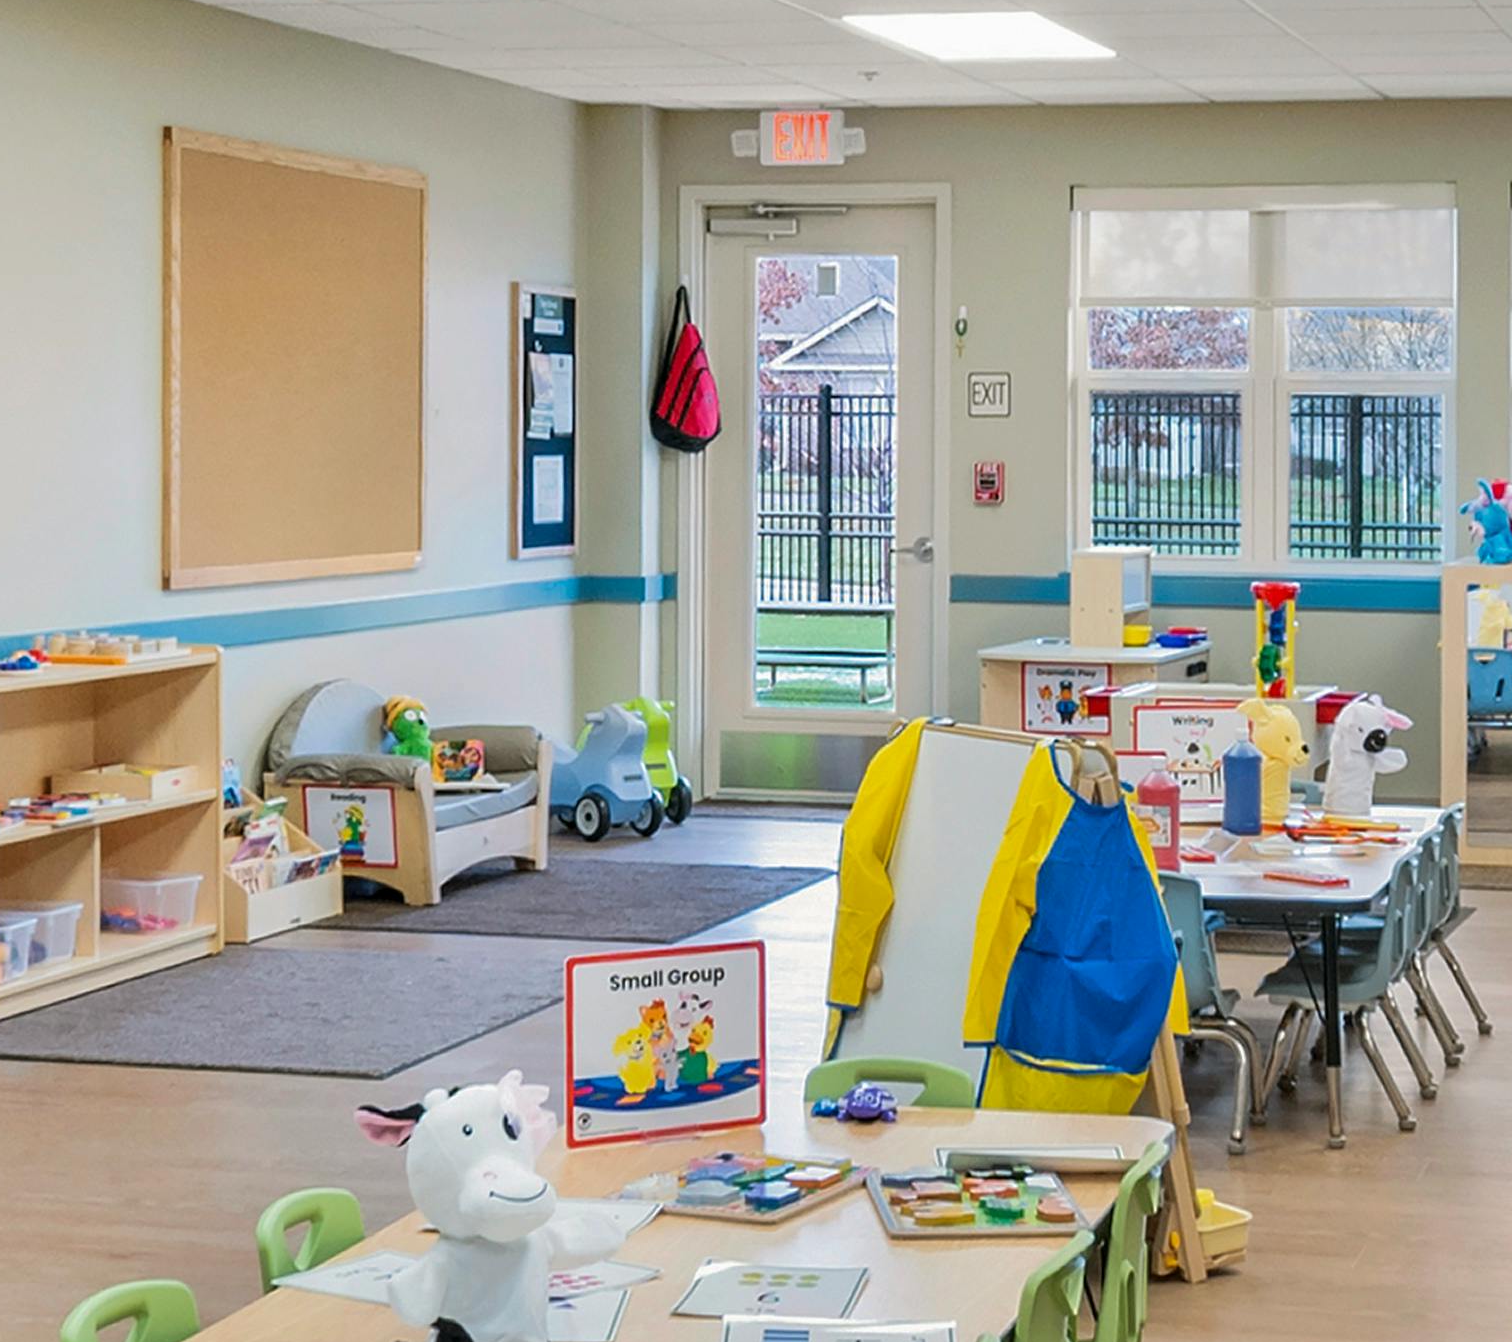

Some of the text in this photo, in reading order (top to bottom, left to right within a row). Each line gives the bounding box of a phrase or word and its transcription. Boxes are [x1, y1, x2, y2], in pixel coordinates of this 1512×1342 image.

[774, 112, 831, 162] EXIT
[972, 381, 1006, 406] EXIT
[1171, 716, 1215, 728] Writing
[609, 965, 726, 992] Small Group
